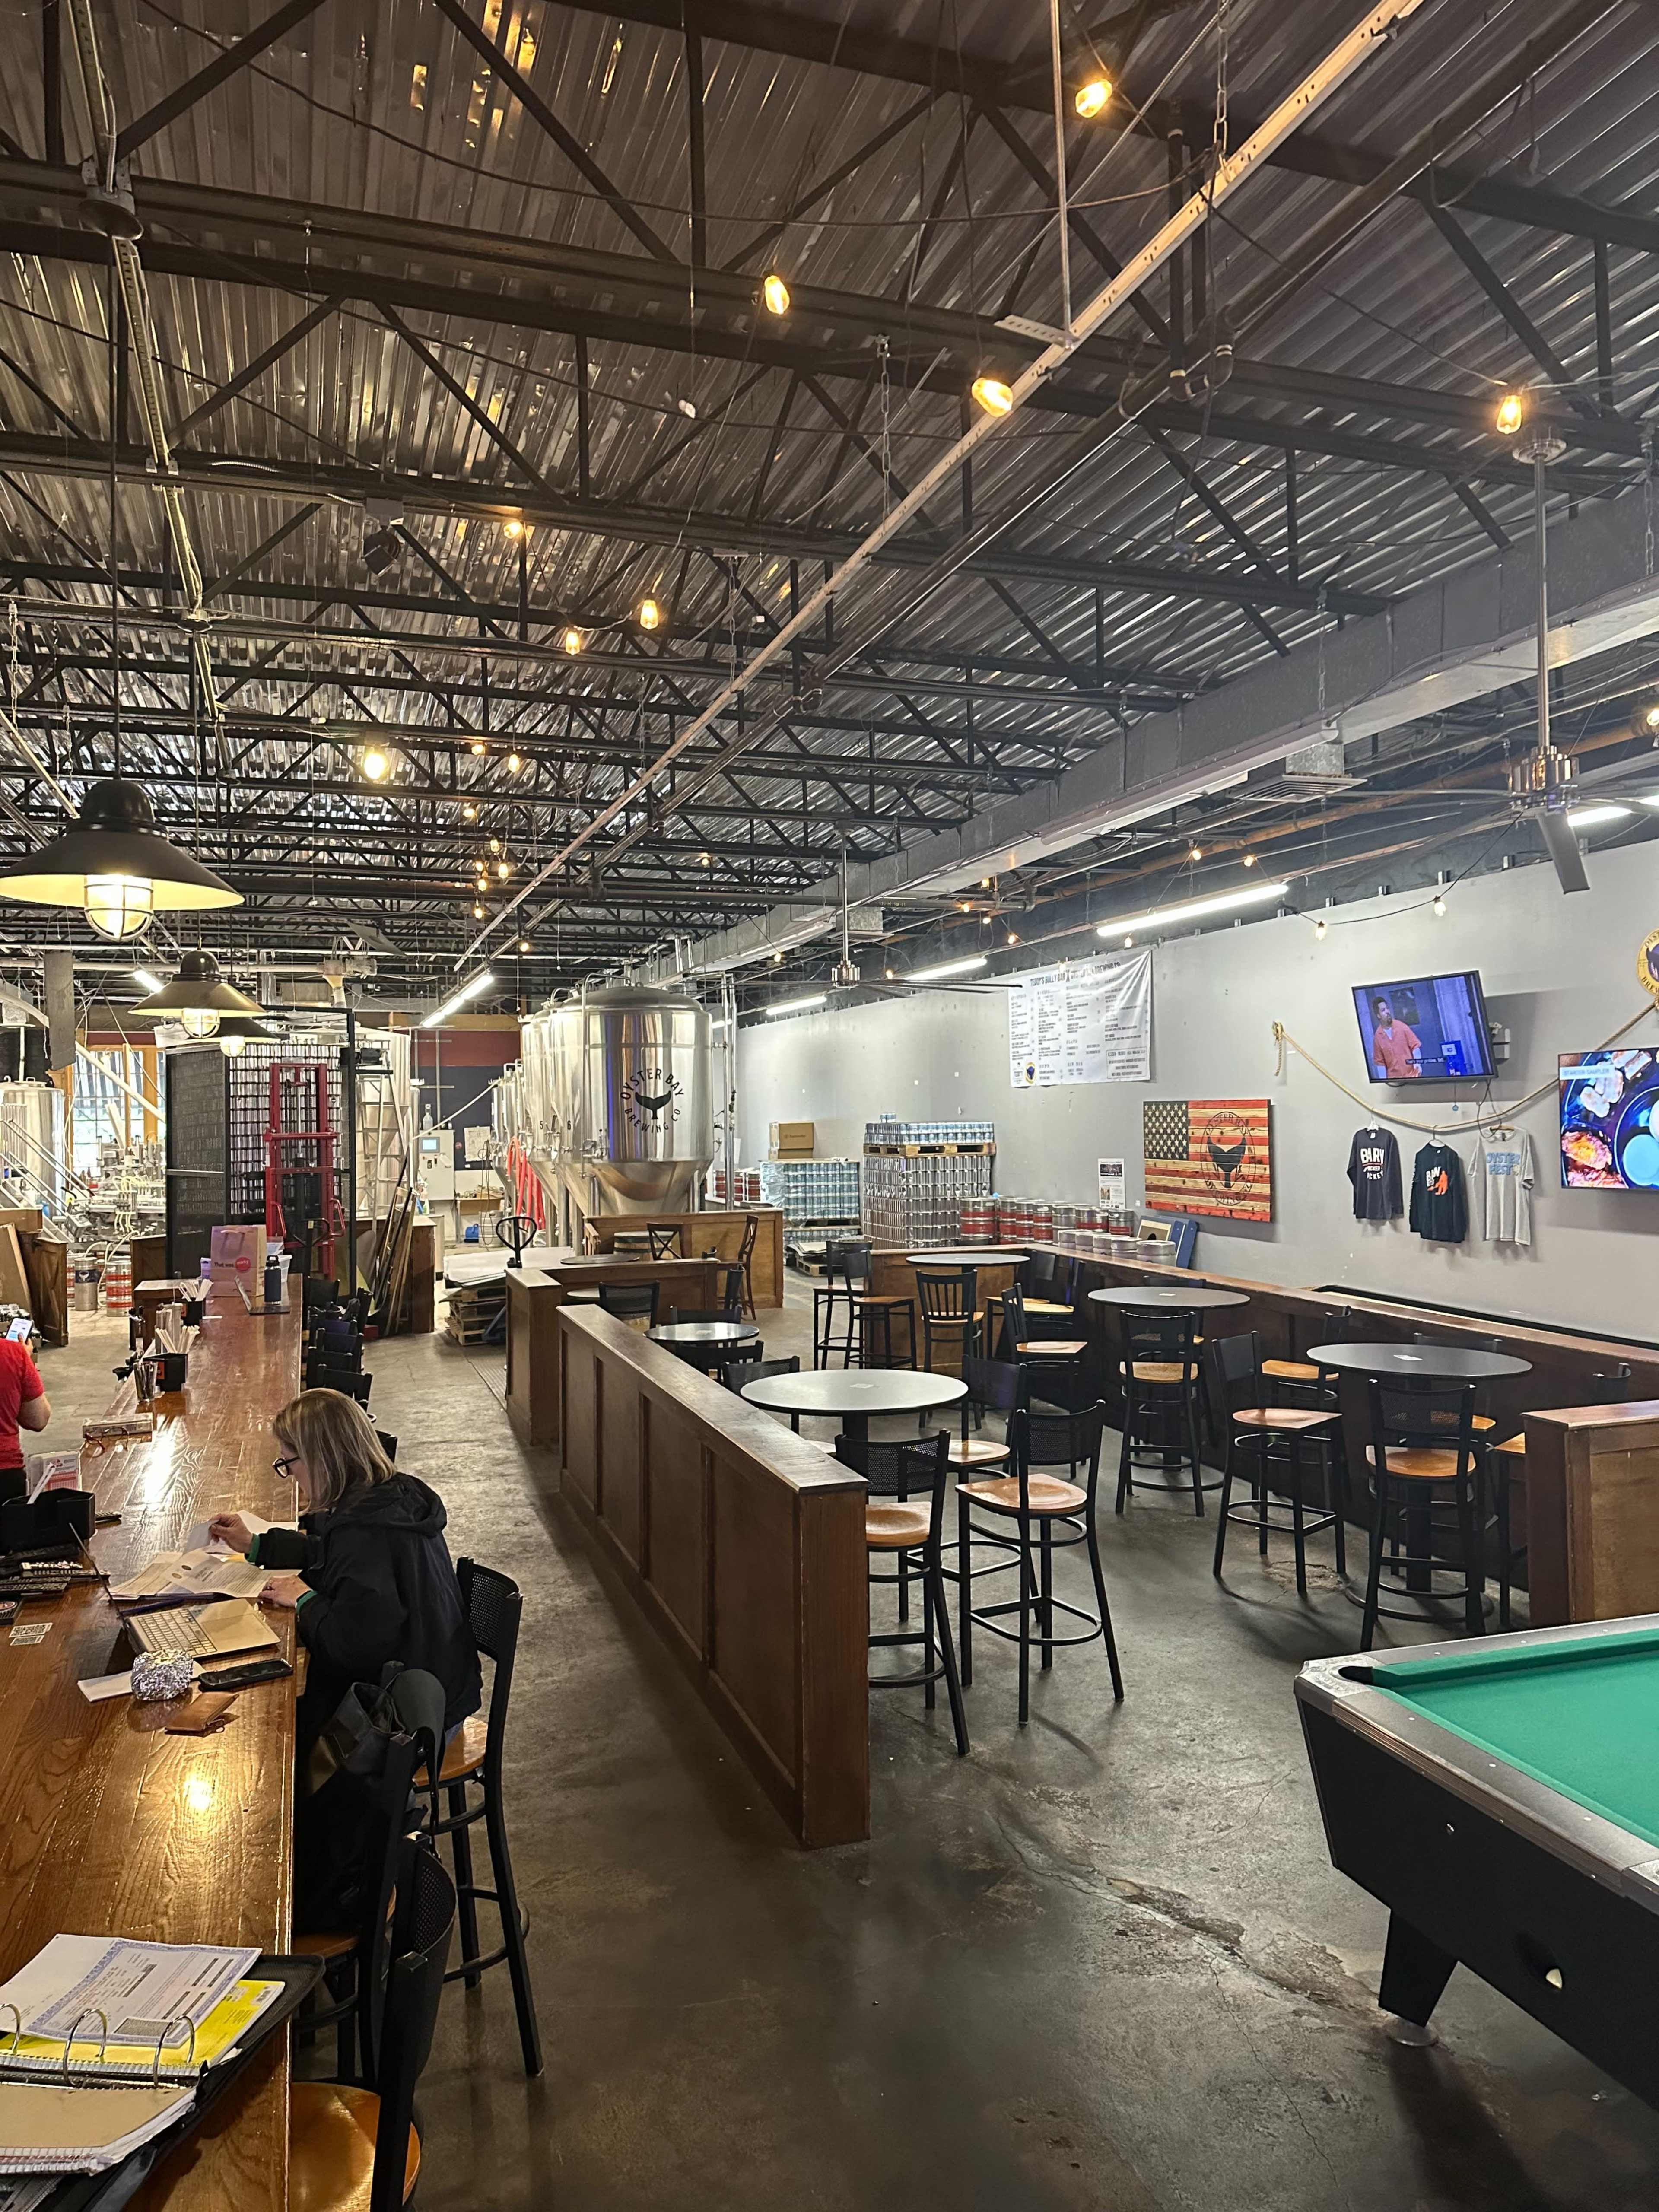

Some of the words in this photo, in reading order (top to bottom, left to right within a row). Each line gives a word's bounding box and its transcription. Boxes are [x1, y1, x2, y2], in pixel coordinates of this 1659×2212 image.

[1065, 969, 1070, 982] X
[620, 1068, 662, 1100] OYSTER
[665, 1073, 684, 1096] BAY
[540, 1120, 543, 1130] 5
[567, 1120, 571, 1131] 6
[624, 1108, 669, 1133] BREWING
[671, 1109, 681, 1122] CO
[1486, 1152, 1521, 1165] OYSTER
[1489, 1164, 1513, 1176] FEST
